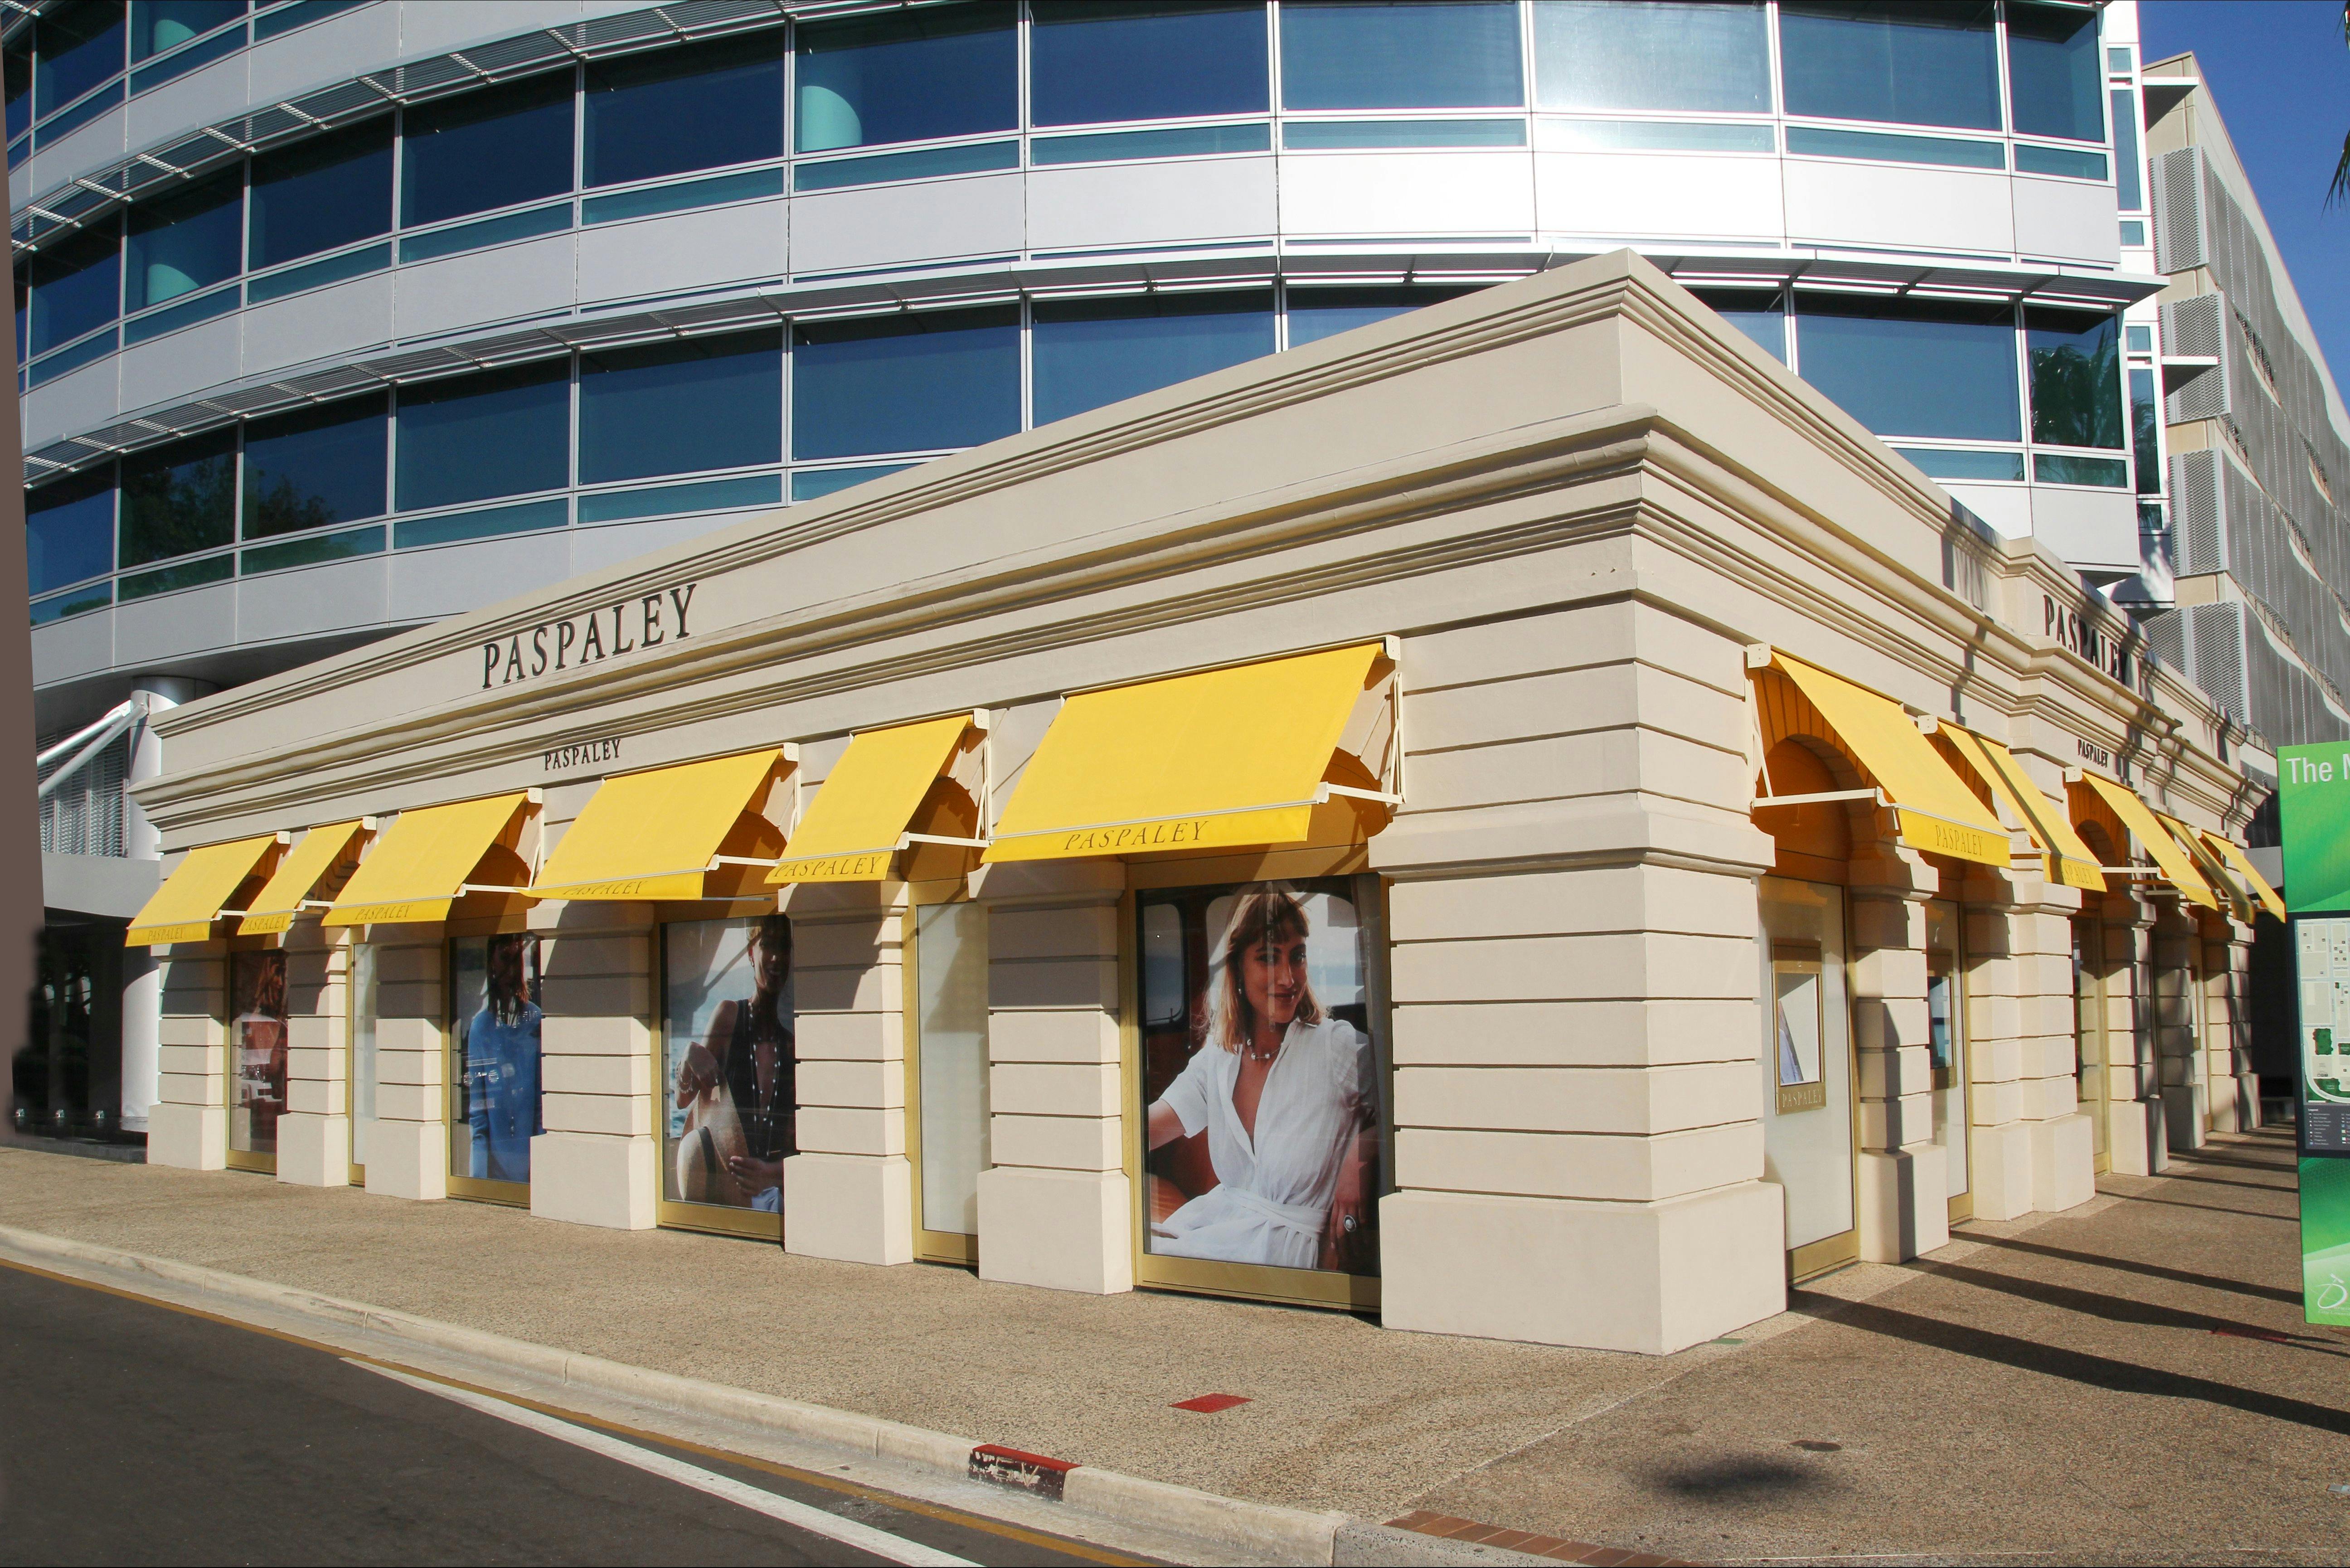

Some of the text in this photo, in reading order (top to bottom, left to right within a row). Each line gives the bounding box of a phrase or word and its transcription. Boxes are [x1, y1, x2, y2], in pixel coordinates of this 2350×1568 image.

[482, 583, 697, 689] PASPALEY
[2043, 594, 2129, 685] PASPALEY
[544, 739, 621, 771] PASPALEY
[2078, 739, 2109, 768] PASPALEY
[2286, 757, 2332, 784] The
[1064, 820, 1209, 850] PASPALEY
[1936, 825, 1984, 856] PASPALEY
[774, 856, 882, 877] PASPALEY
[563, 881, 647, 895] PASPALEY
[242, 916, 288, 931] PASPALEY
[355, 905, 413, 920] PASPALEY
[148, 927, 185, 941] PASPALEY
[1782, 1090, 1822, 1107] PASPALEY
